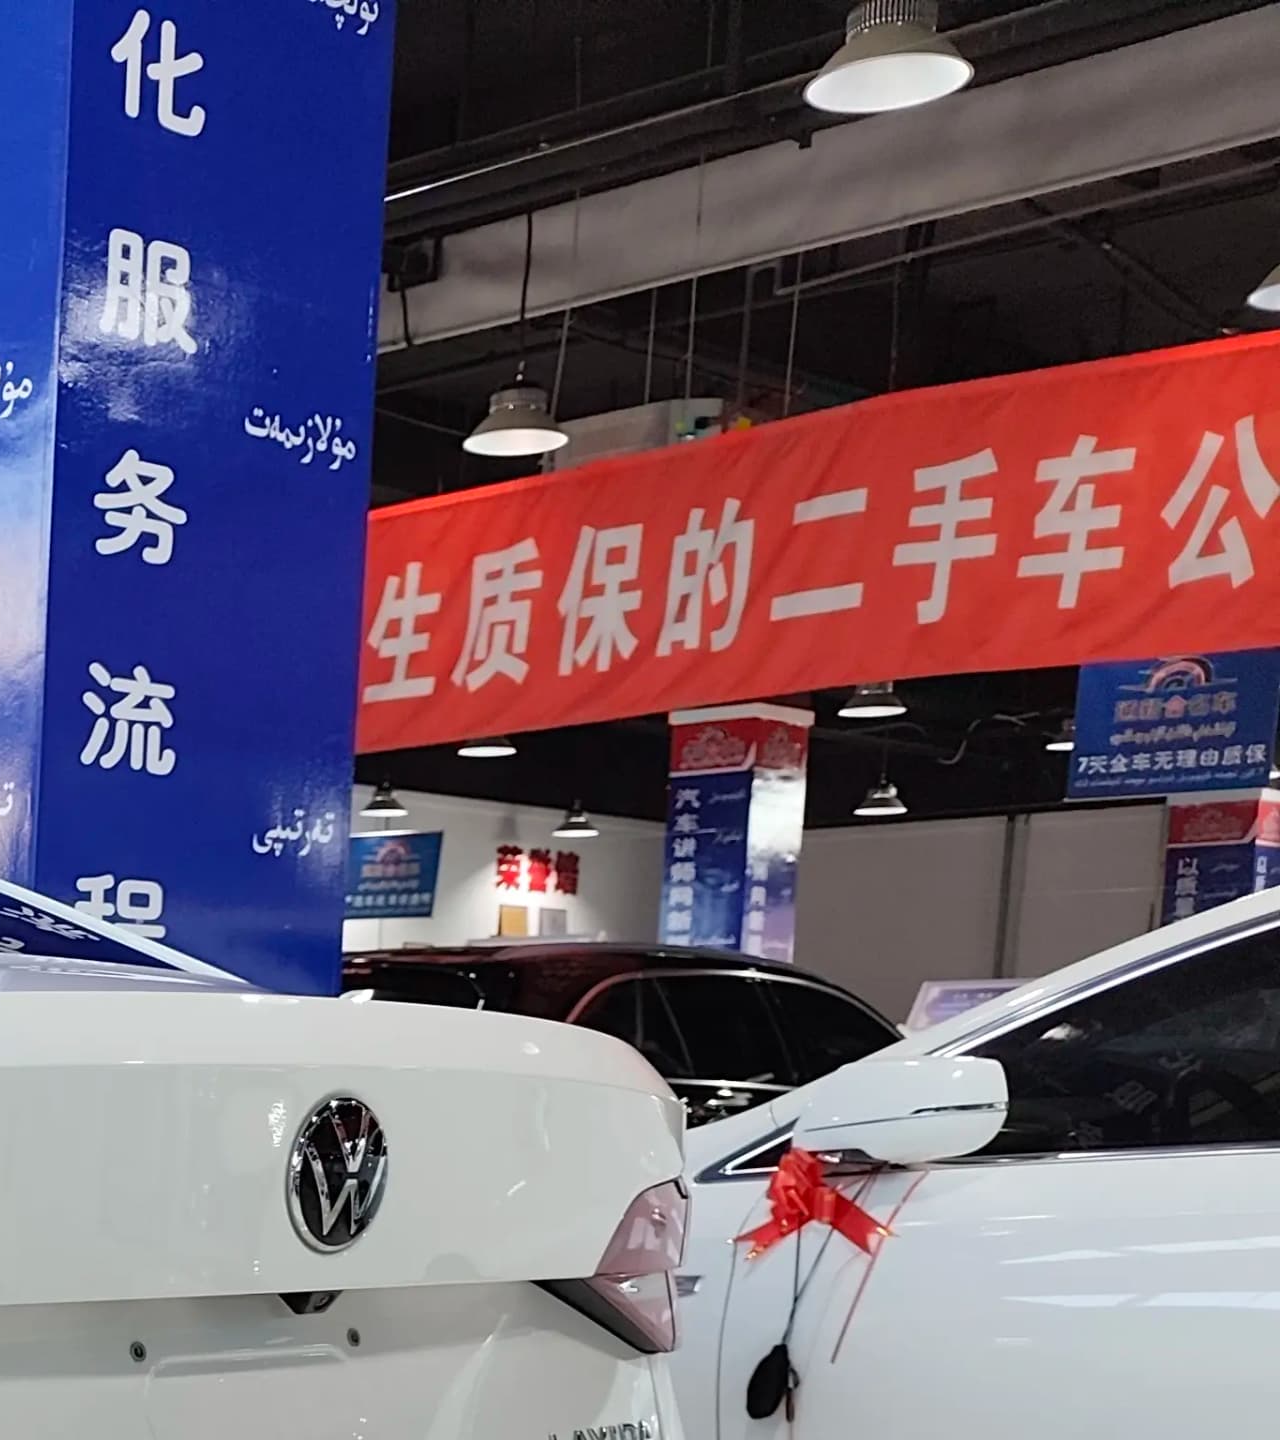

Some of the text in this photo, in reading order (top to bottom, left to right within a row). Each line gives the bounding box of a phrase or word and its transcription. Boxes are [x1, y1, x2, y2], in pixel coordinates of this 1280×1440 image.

[74, 9, 206, 939] 化服务流程
[362, 416, 1280, 704] 生质保的二手车公
[1077, 743, 1267, 775] 7天全车无理由质保
